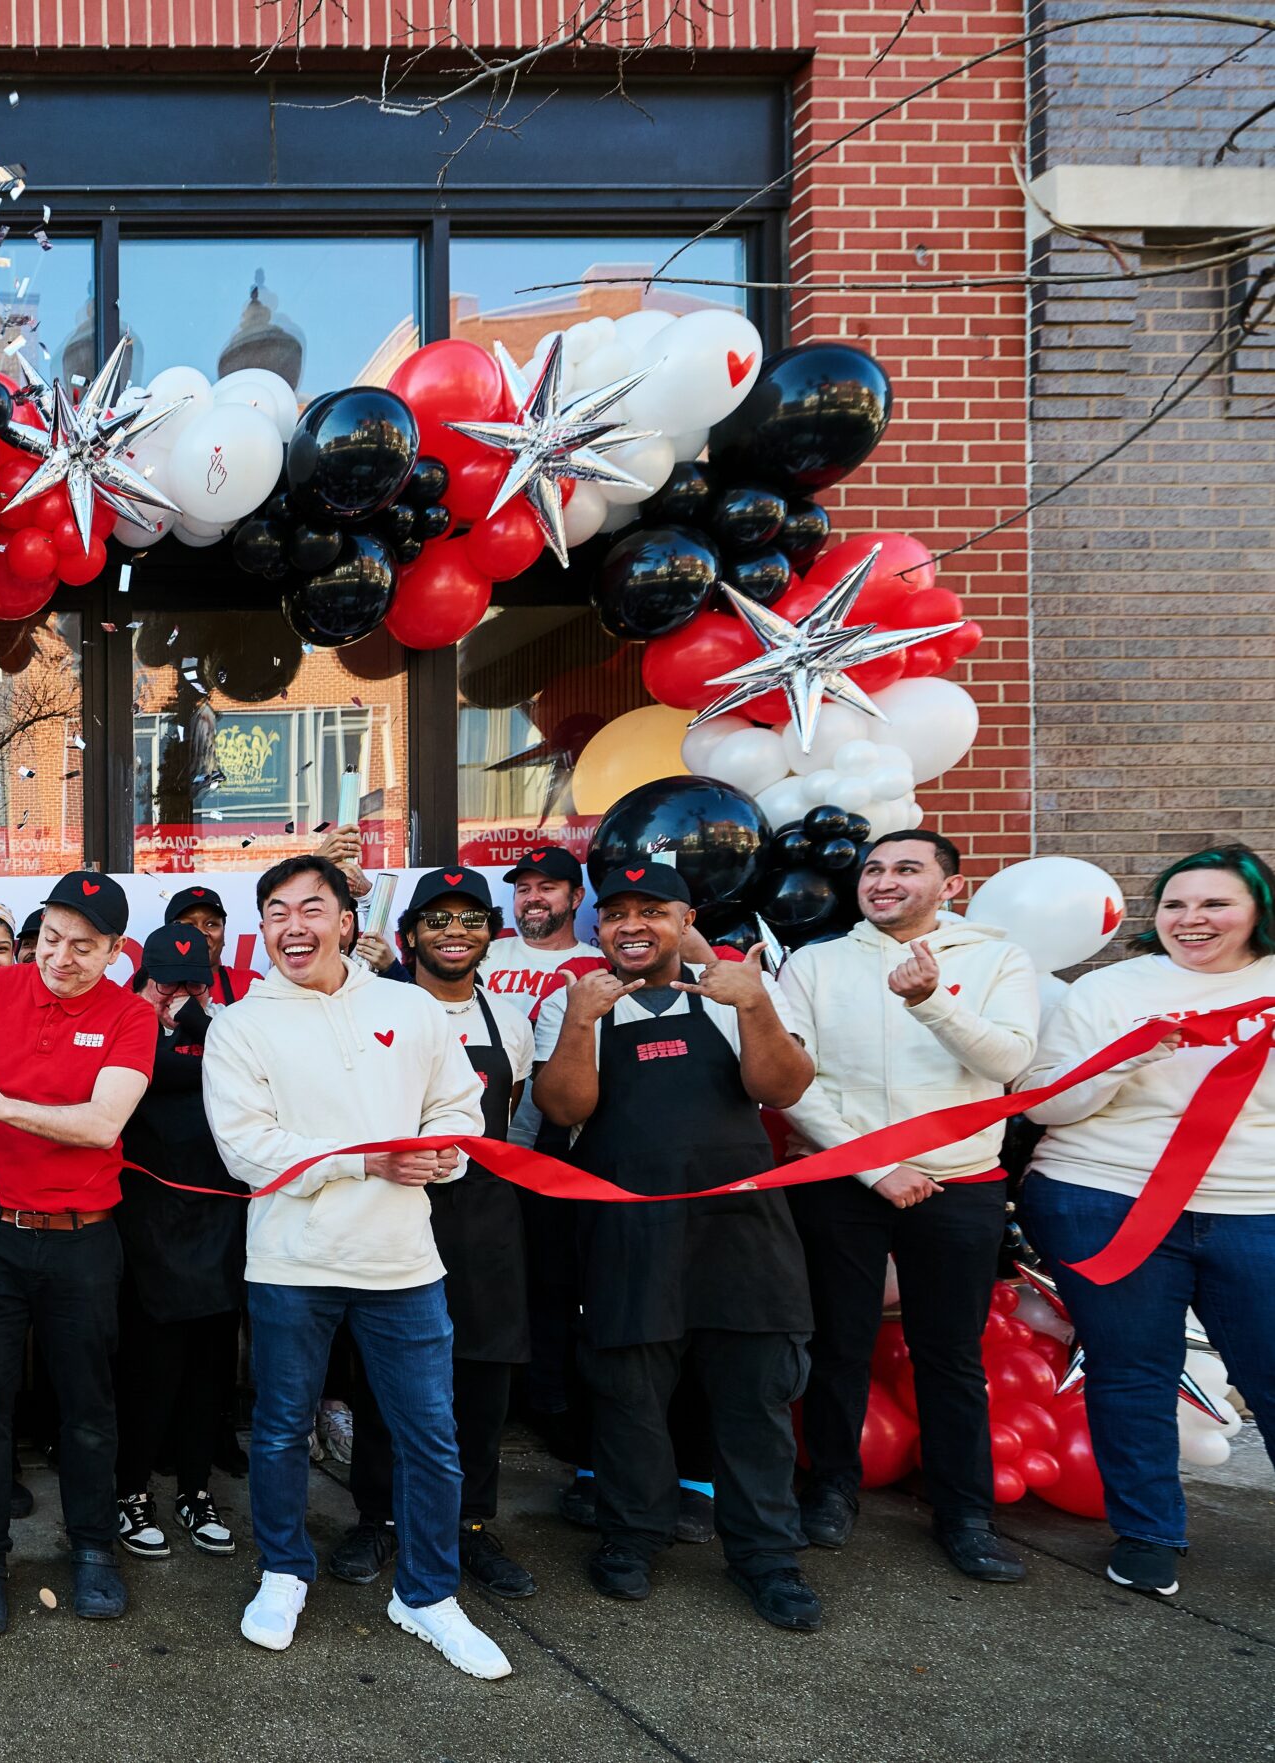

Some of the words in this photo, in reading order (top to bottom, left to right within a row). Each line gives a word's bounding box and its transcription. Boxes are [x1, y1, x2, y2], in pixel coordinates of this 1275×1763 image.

[460, 829, 519, 842] GRAND
[138, 836, 201, 849] GRAND
[637, 1040, 687, 1053] SEOUL
